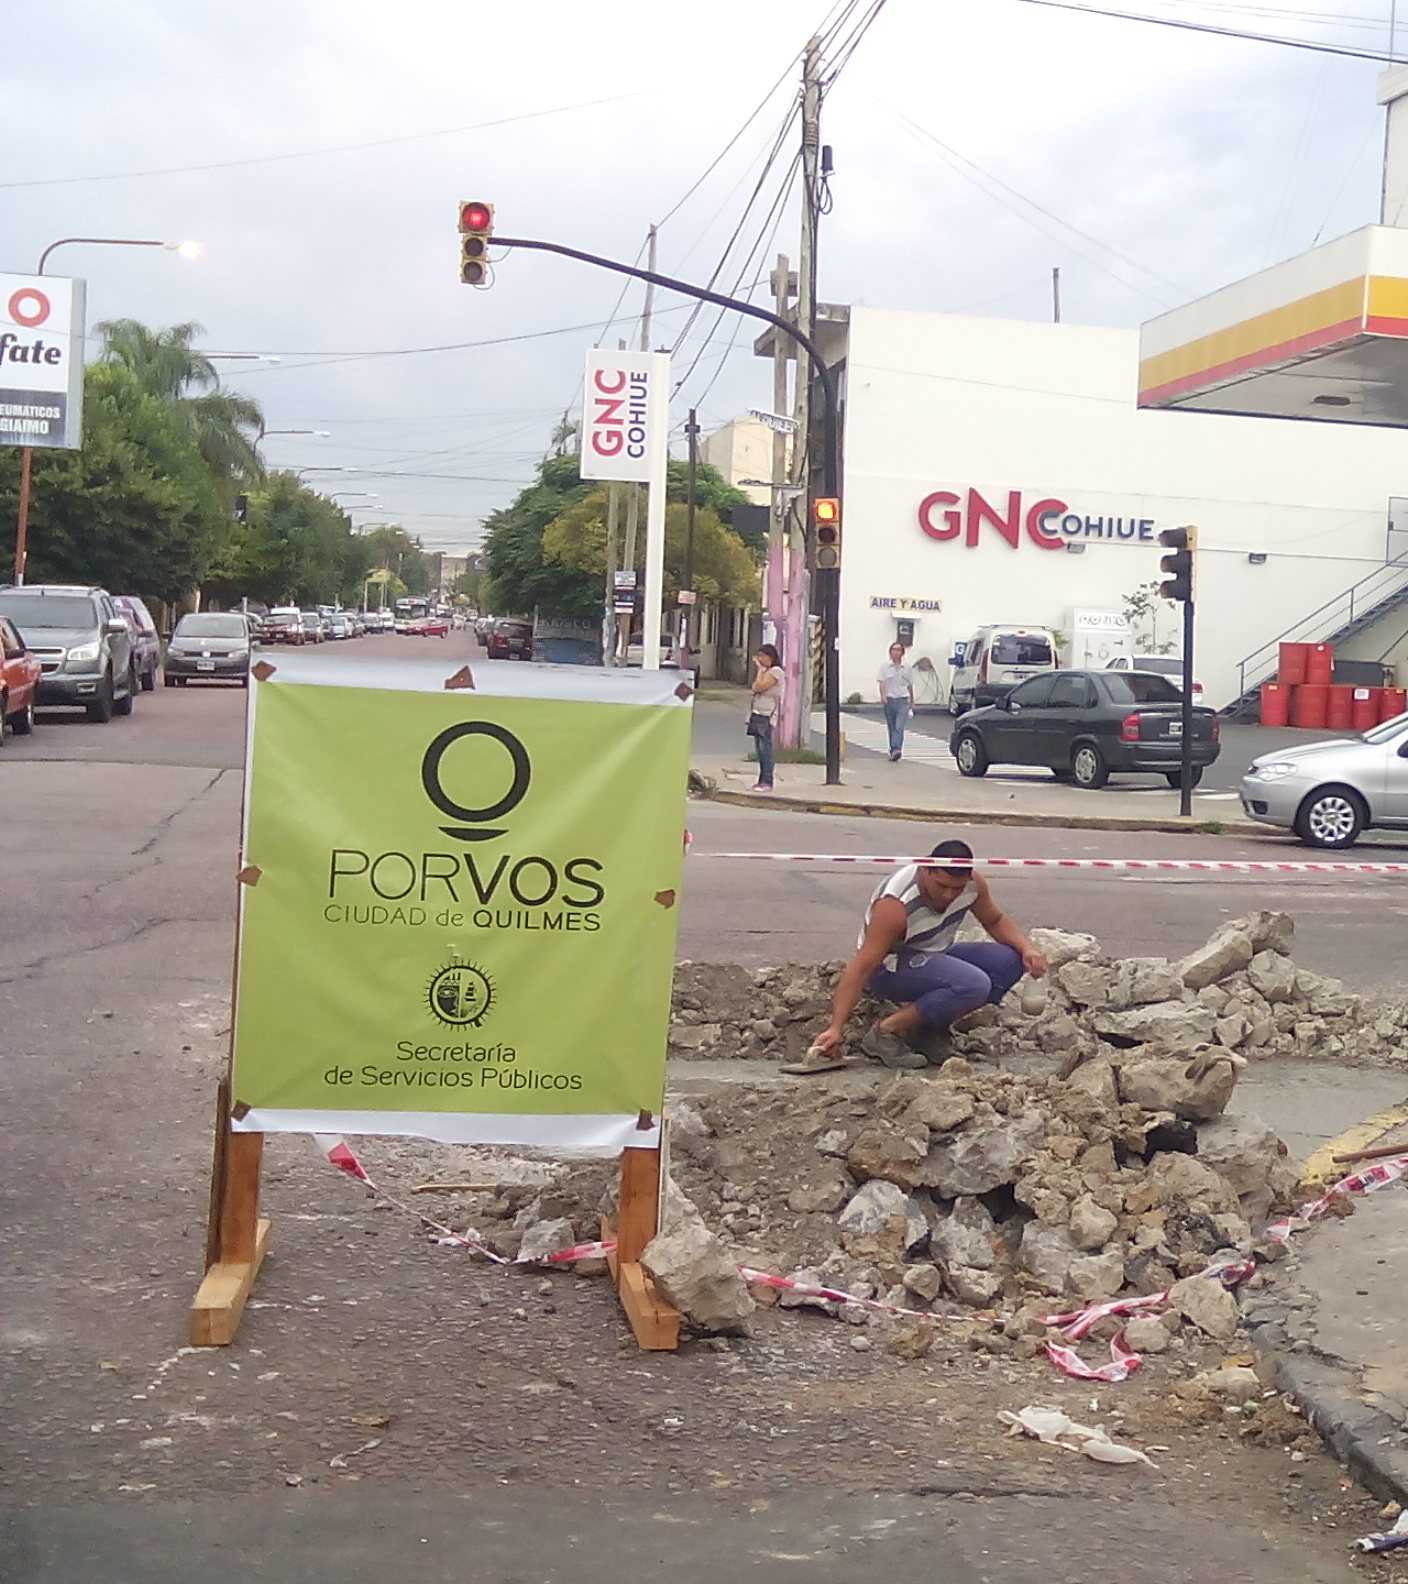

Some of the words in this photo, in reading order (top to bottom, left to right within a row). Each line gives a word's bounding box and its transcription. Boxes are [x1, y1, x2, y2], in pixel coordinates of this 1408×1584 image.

[0, 333, 61, 365] fate
[0, 405, 60, 418] EUMATICOS
[592, 369, 627, 456] GNC
[627, 372, 647, 458] COHIUE
[918, 487, 1069, 549] GNC
[1039, 509, 1155, 540] COHIUE
[872, 598, 896, 608] AIRE
[900, 600, 907, 608] Y
[910, 600, 940, 611] AGUA
[324, 904, 427, 926] CIUDAD
[435, 908, 464, 927] de
[473, 909, 601, 931] QUILMES
[396, 1041, 516, 1063] Secretaría
[324, 1065, 353, 1086] de
[360, 1065, 474, 1088] Servicios
[481, 1067, 582, 1091] Públicos
